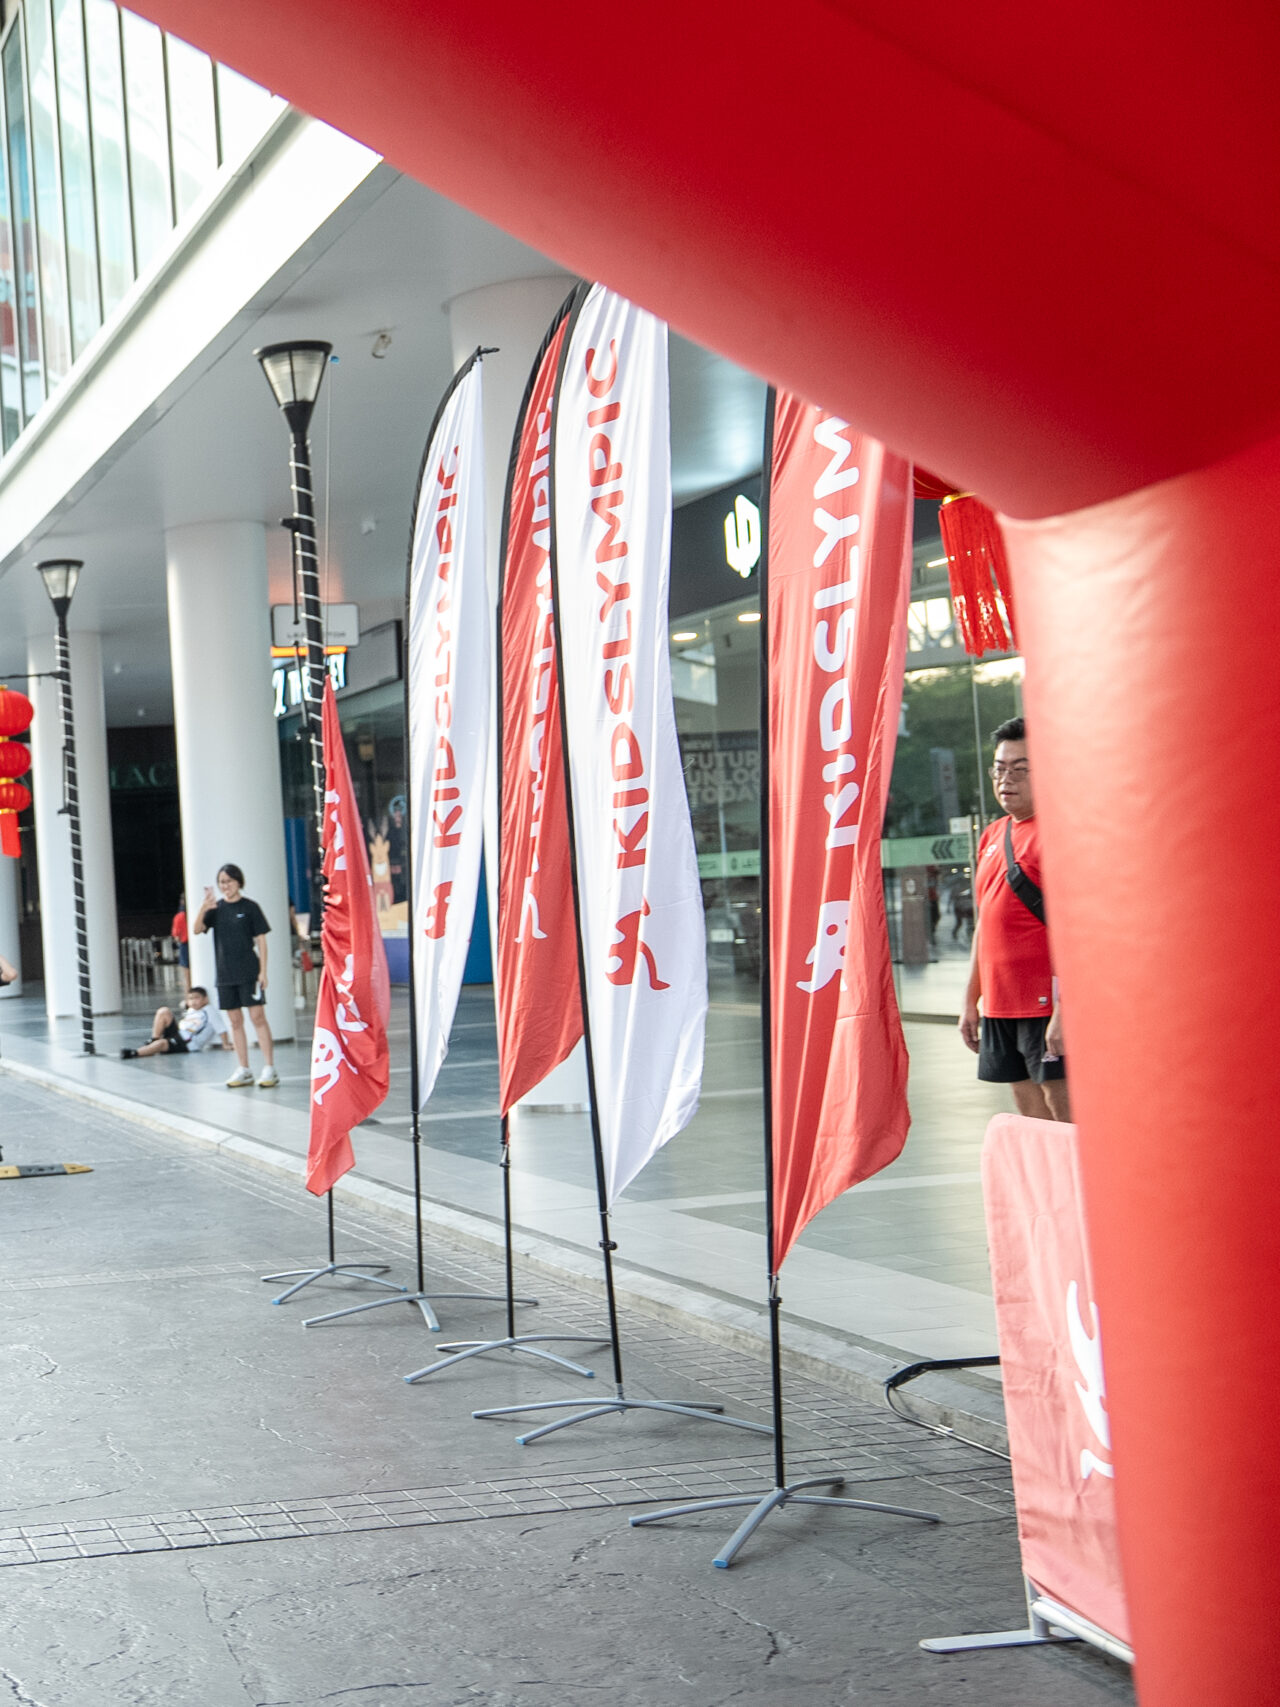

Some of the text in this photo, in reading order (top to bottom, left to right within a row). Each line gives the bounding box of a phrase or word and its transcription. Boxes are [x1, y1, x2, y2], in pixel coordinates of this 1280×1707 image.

[586, 338, 648, 870] KIDSLYMPIC
[813, 406, 861, 851] KIDSLYM
[684, 751, 760, 769] FUTUR
[688, 783, 759, 804] TODA
